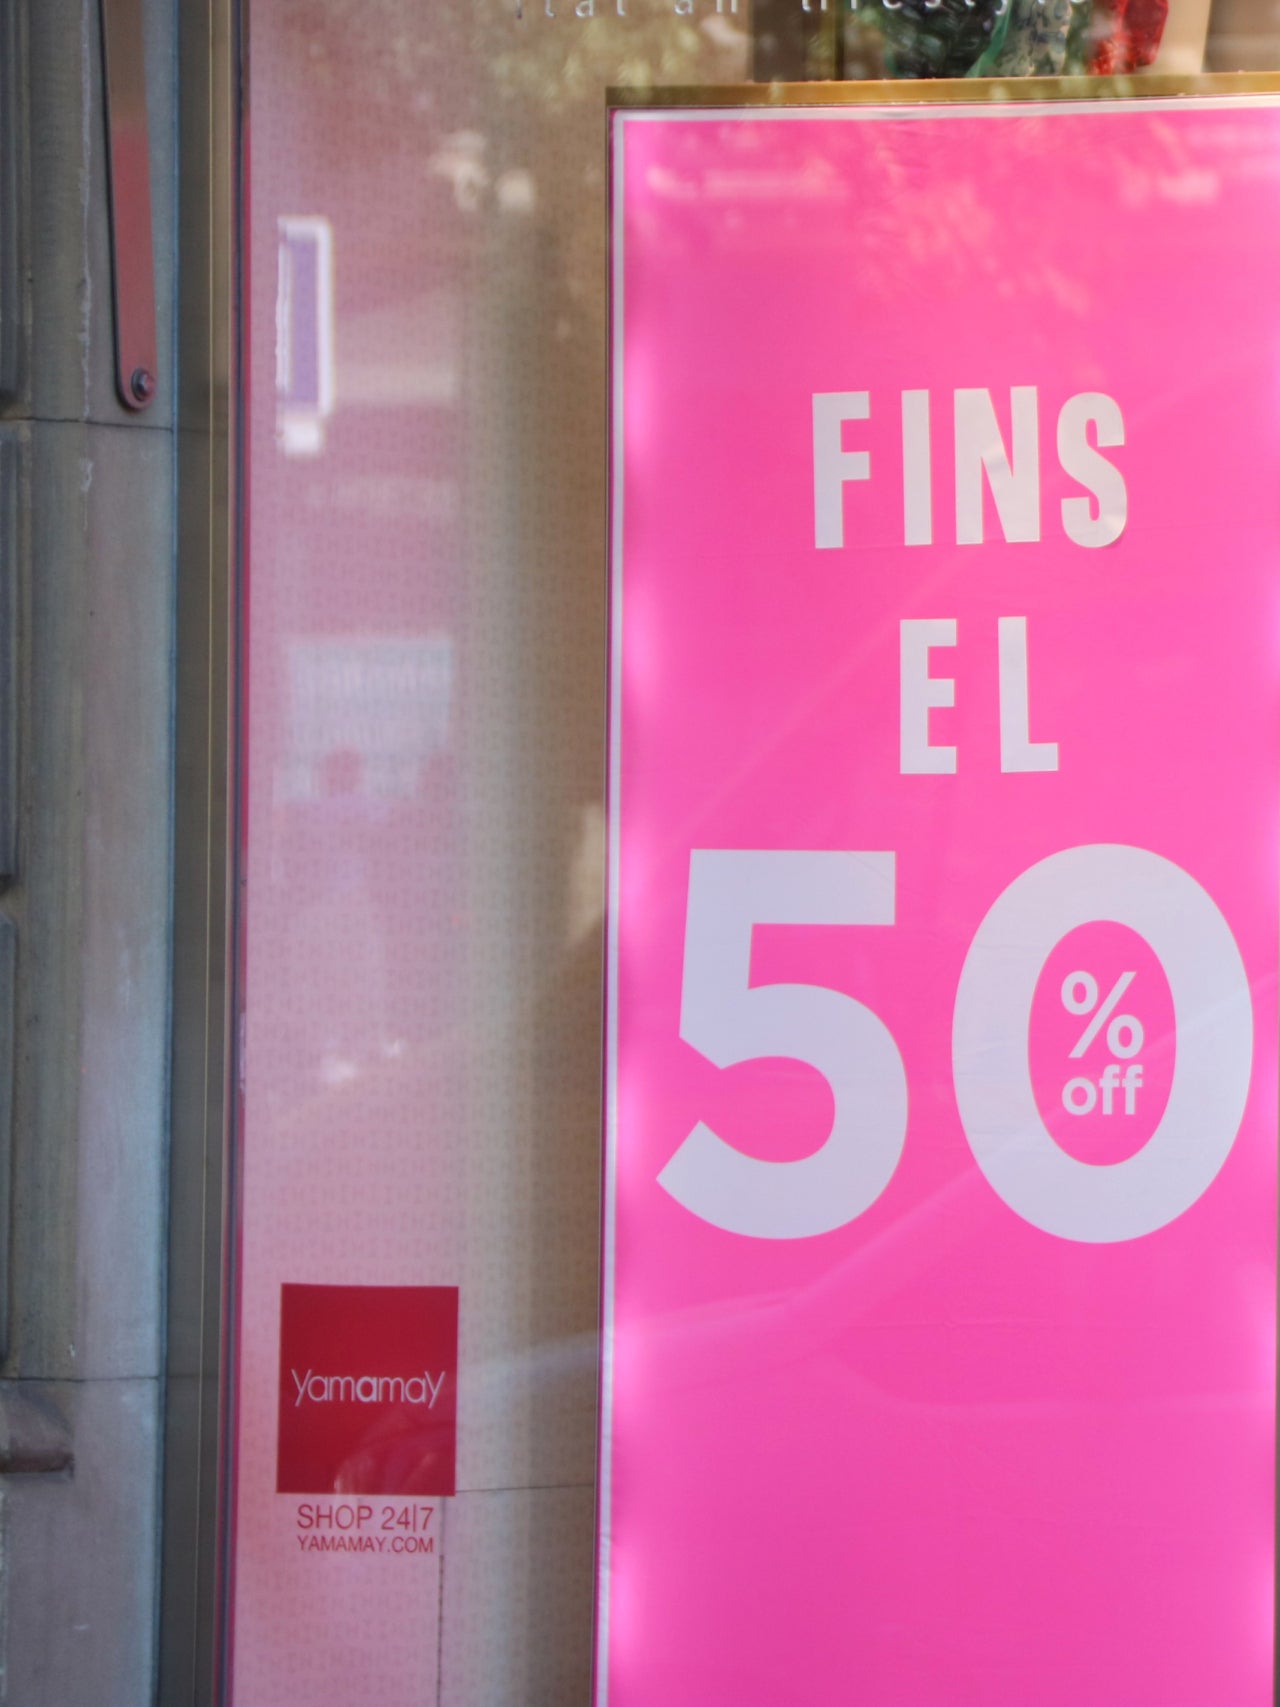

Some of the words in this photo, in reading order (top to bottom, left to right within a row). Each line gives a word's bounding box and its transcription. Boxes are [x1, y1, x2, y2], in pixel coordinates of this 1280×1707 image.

[812, 385, 1128, 549] FINS
[900, 616, 1059, 774] EL
[655, 843, 1254, 1243] 50
[1061, 970, 1144, 1059] %
[1061, 1064, 1144, 1116] off
[291, 1369, 446, 1409] yamamay
[297, 1504, 373, 1530] SHOP
[297, 1535, 435, 1553] YAMAMAY.COM
